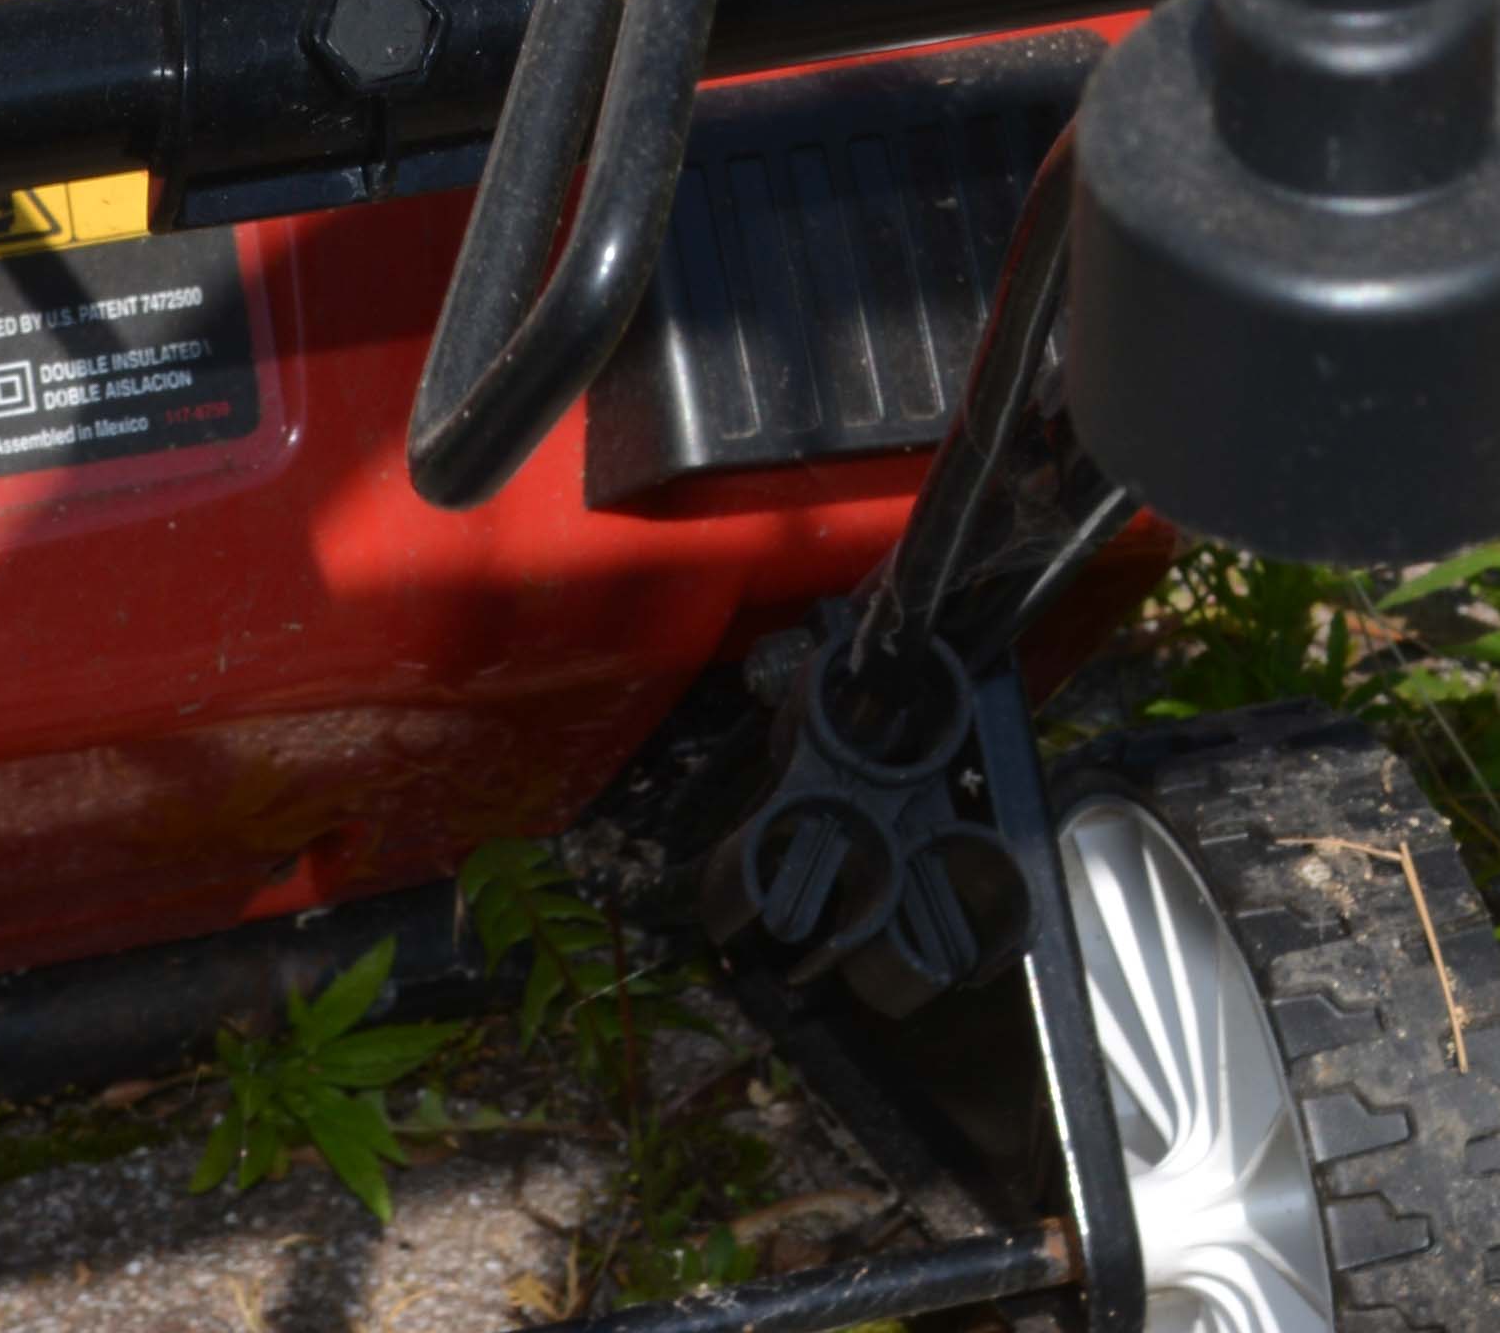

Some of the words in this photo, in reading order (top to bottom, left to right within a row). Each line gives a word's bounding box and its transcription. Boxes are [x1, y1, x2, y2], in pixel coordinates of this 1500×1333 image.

[19, 313, 41, 333] BY
[45, 307, 76, 328] U.S.
[79, 296, 138, 320] PATENT
[140, 285, 203, 314] 7472500
[38, 354, 109, 384] DOUBLE
[110, 339, 201, 371] INSULATED
[42, 383, 100, 410] DOBLE
[104, 370, 192, 399] AISLACION
[77, 424, 92, 441] in
[94, 415, 149, 438] Mexico
